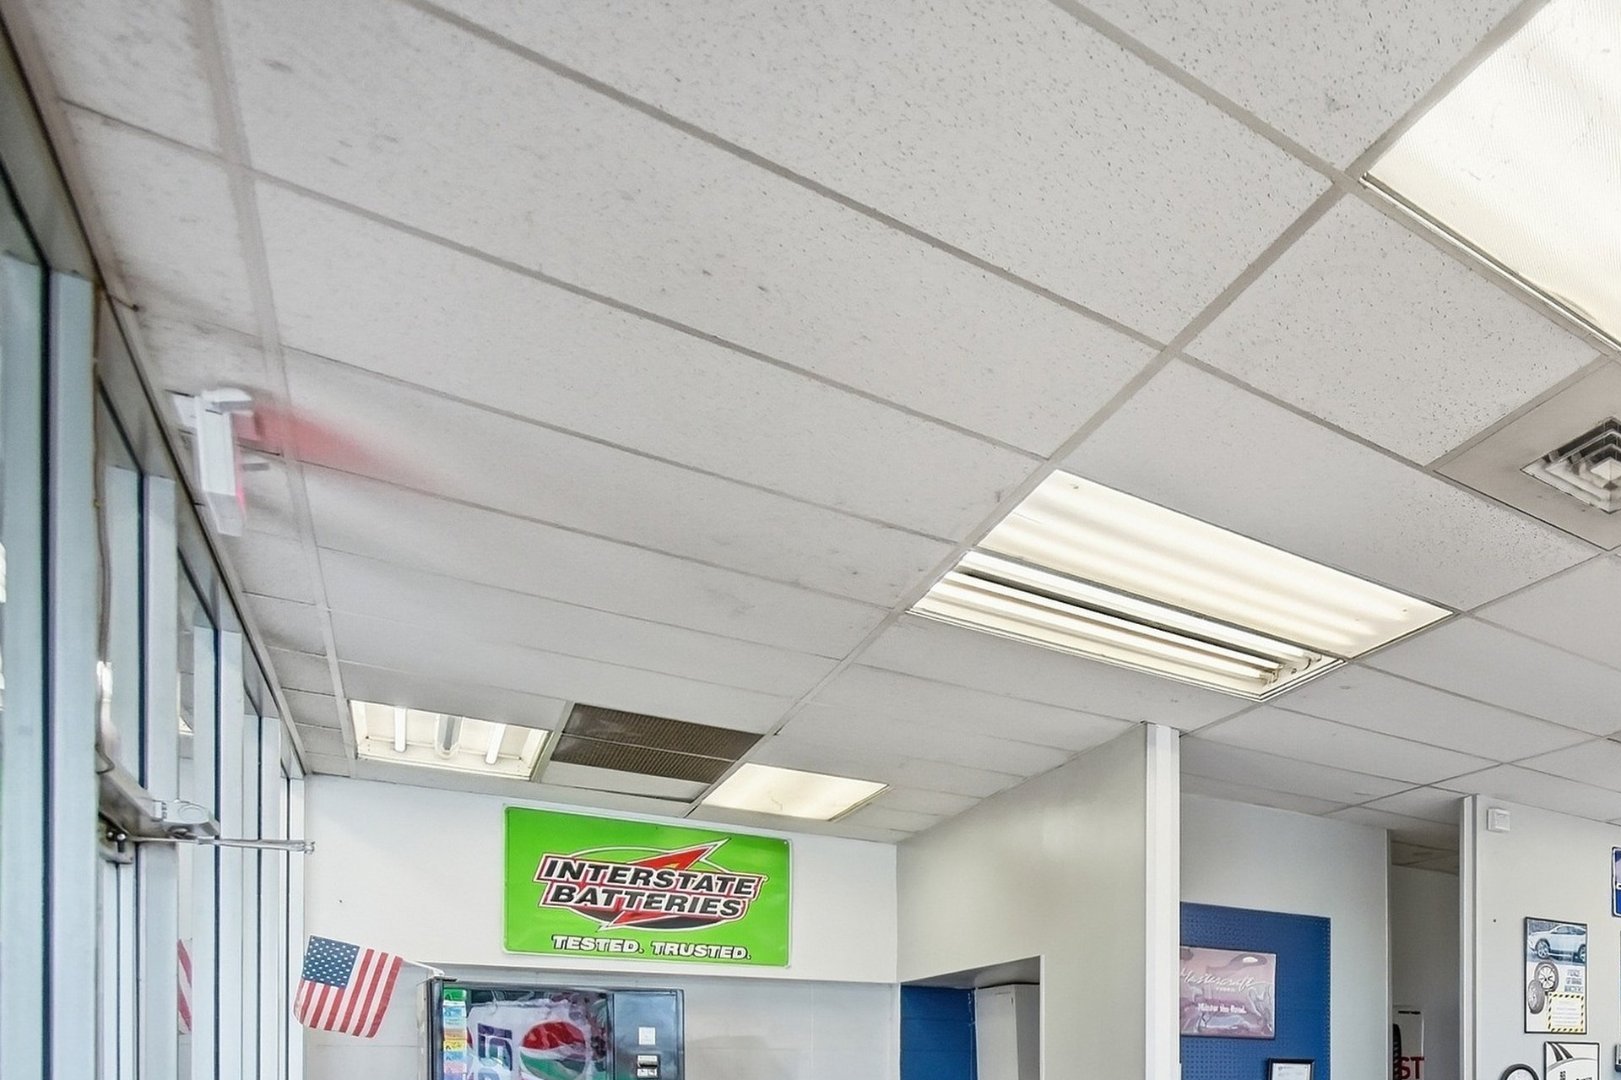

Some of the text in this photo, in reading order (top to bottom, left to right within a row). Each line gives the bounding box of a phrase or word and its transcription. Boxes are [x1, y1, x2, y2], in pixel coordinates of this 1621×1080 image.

[543, 859, 757, 896] INTERSTATE
[549, 884, 743, 917] BATTERIES
[552, 934, 752, 960] TESTED. TRUSTED.
